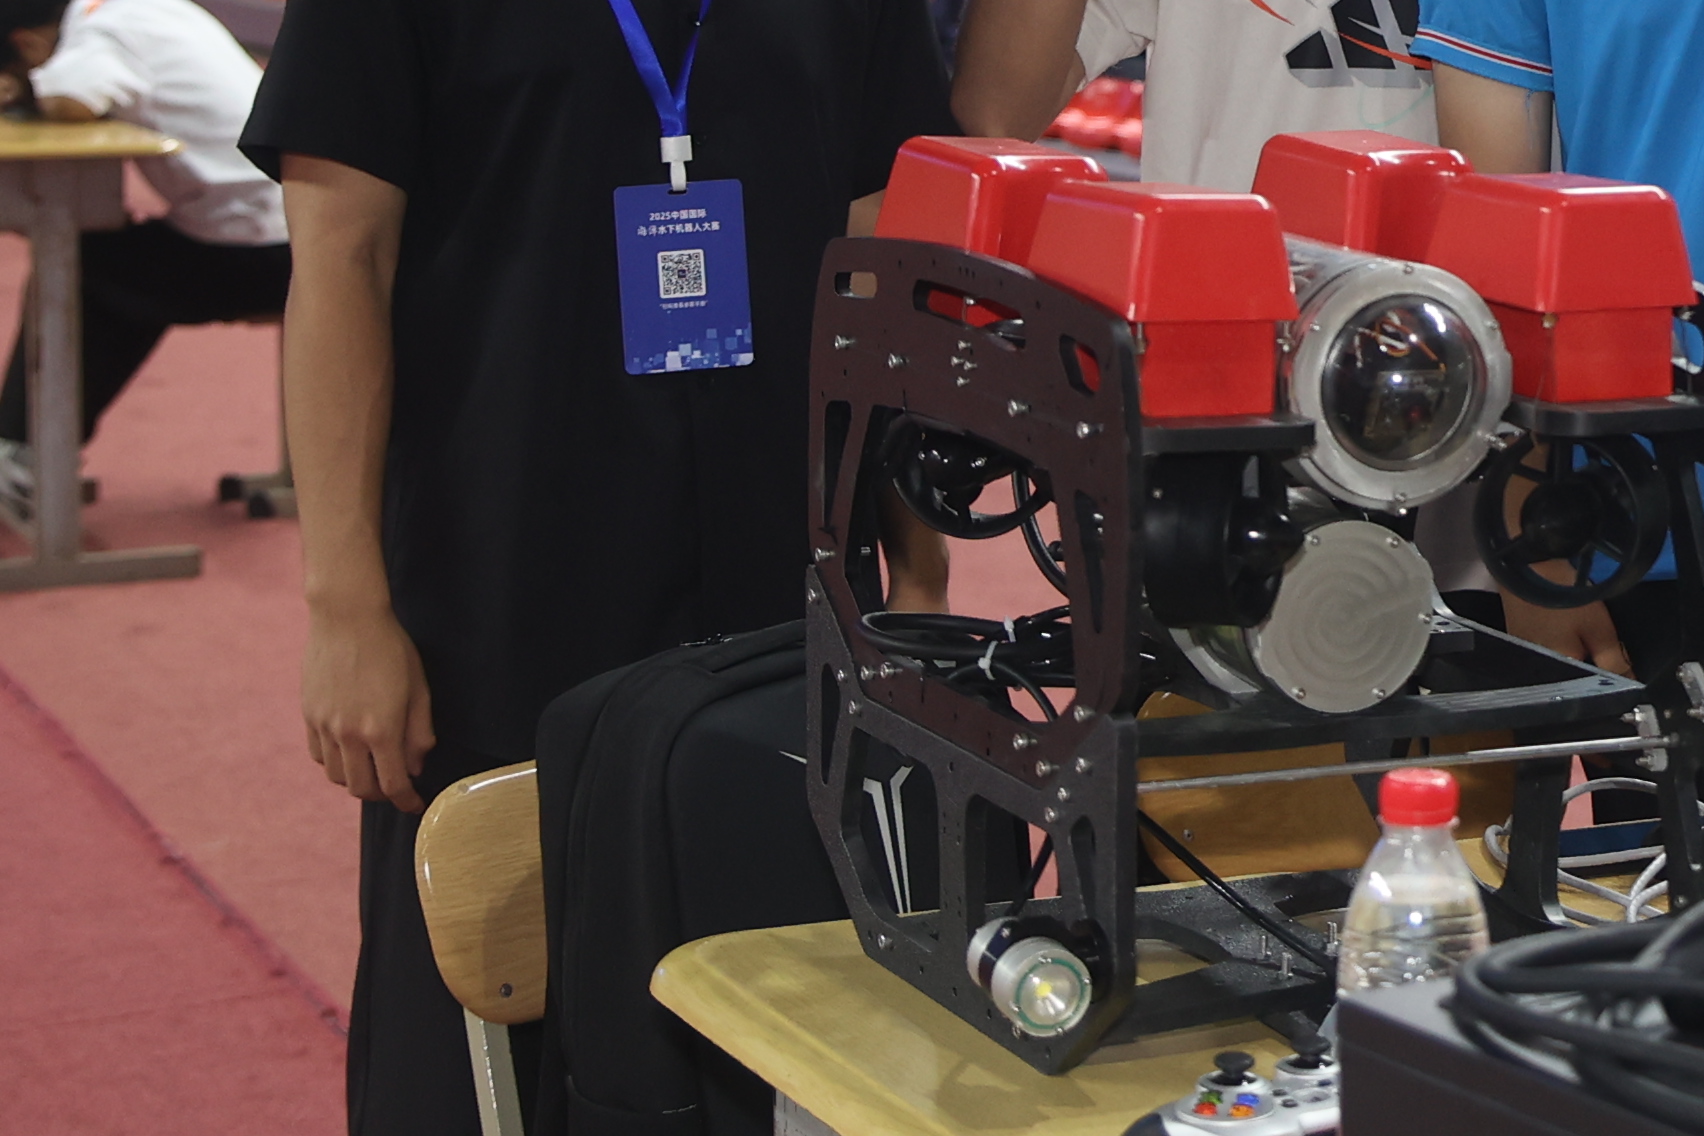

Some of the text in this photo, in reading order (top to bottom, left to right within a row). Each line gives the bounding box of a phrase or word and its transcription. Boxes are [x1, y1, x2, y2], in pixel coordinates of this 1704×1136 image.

[649, 209, 707, 221] 2025中国国际
[637, 221, 720, 236] 海洋水下机器人大赛
